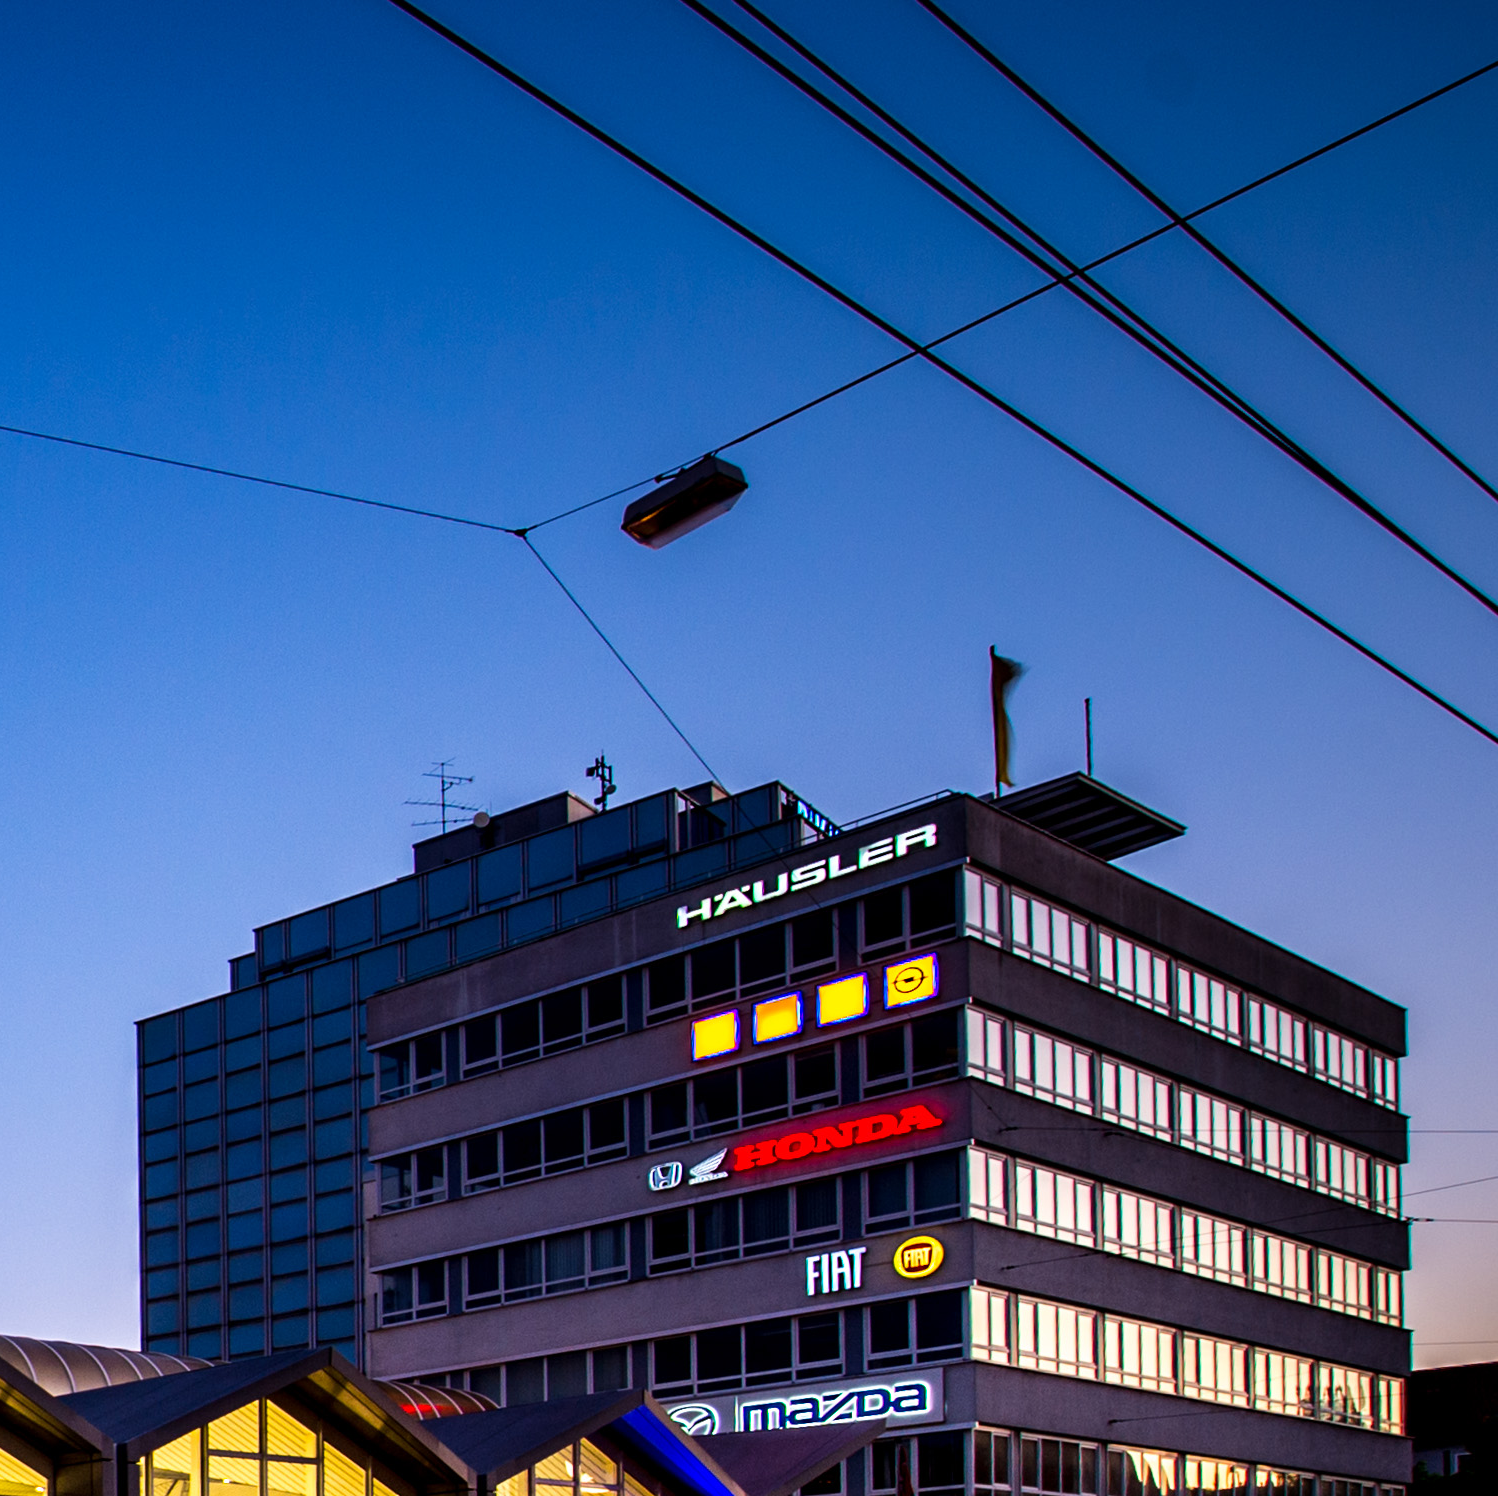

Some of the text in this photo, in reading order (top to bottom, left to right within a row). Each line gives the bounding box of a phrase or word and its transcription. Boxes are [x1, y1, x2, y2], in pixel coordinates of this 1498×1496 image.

[677, 824, 937, 928] HÄUSLER
[734, 1104, 943, 1172] HONDA
[805, 1246, 866, 1296] FIAT
[904, 1247, 931, 1268] FIAT
